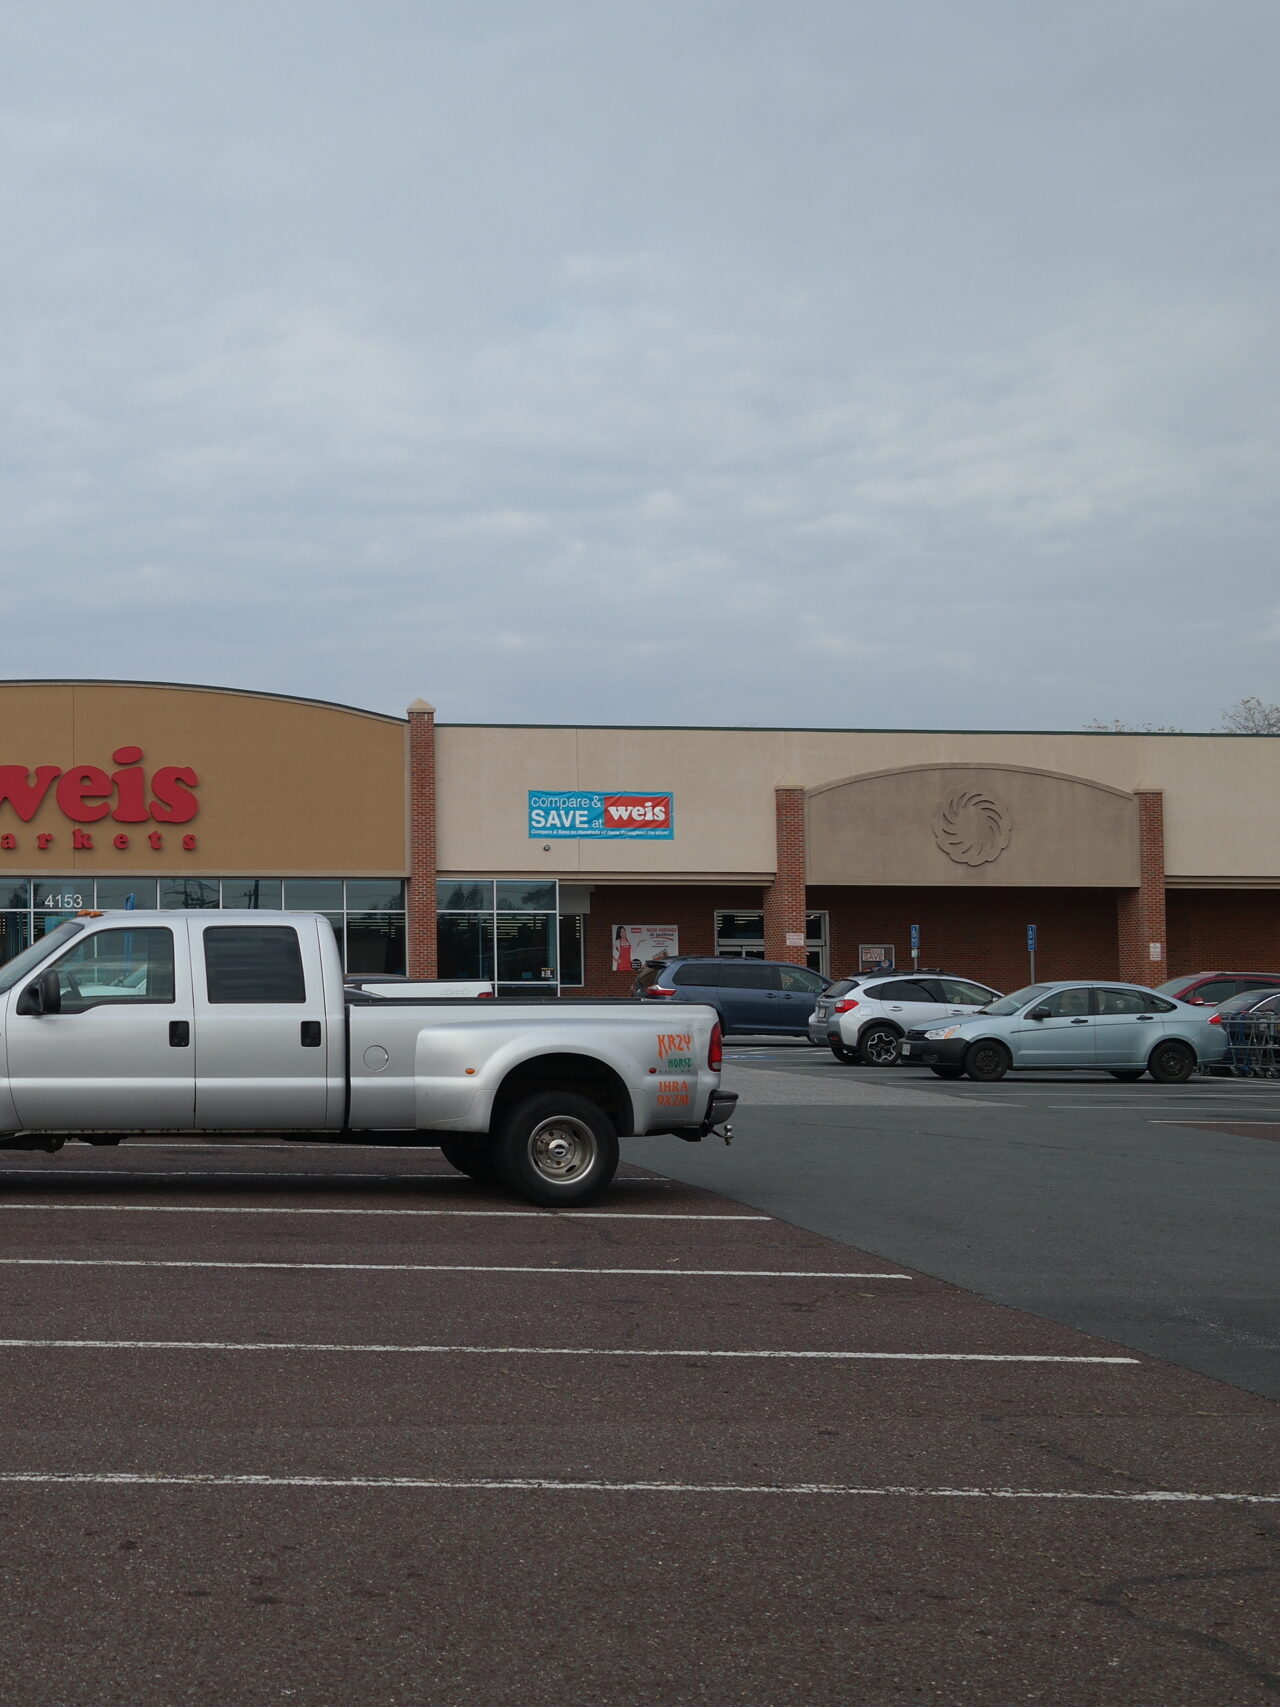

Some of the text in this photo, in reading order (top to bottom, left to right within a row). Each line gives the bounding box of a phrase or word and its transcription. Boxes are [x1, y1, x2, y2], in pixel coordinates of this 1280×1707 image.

[531, 795, 602, 810] compare &
[531, 809, 604, 828] SAVE at
[607, 802, 666, 821] weis
[44, 894, 83, 908] 4153
[864, 953, 883, 961] SAVE
[656, 1033, 691, 1061] KRZY
